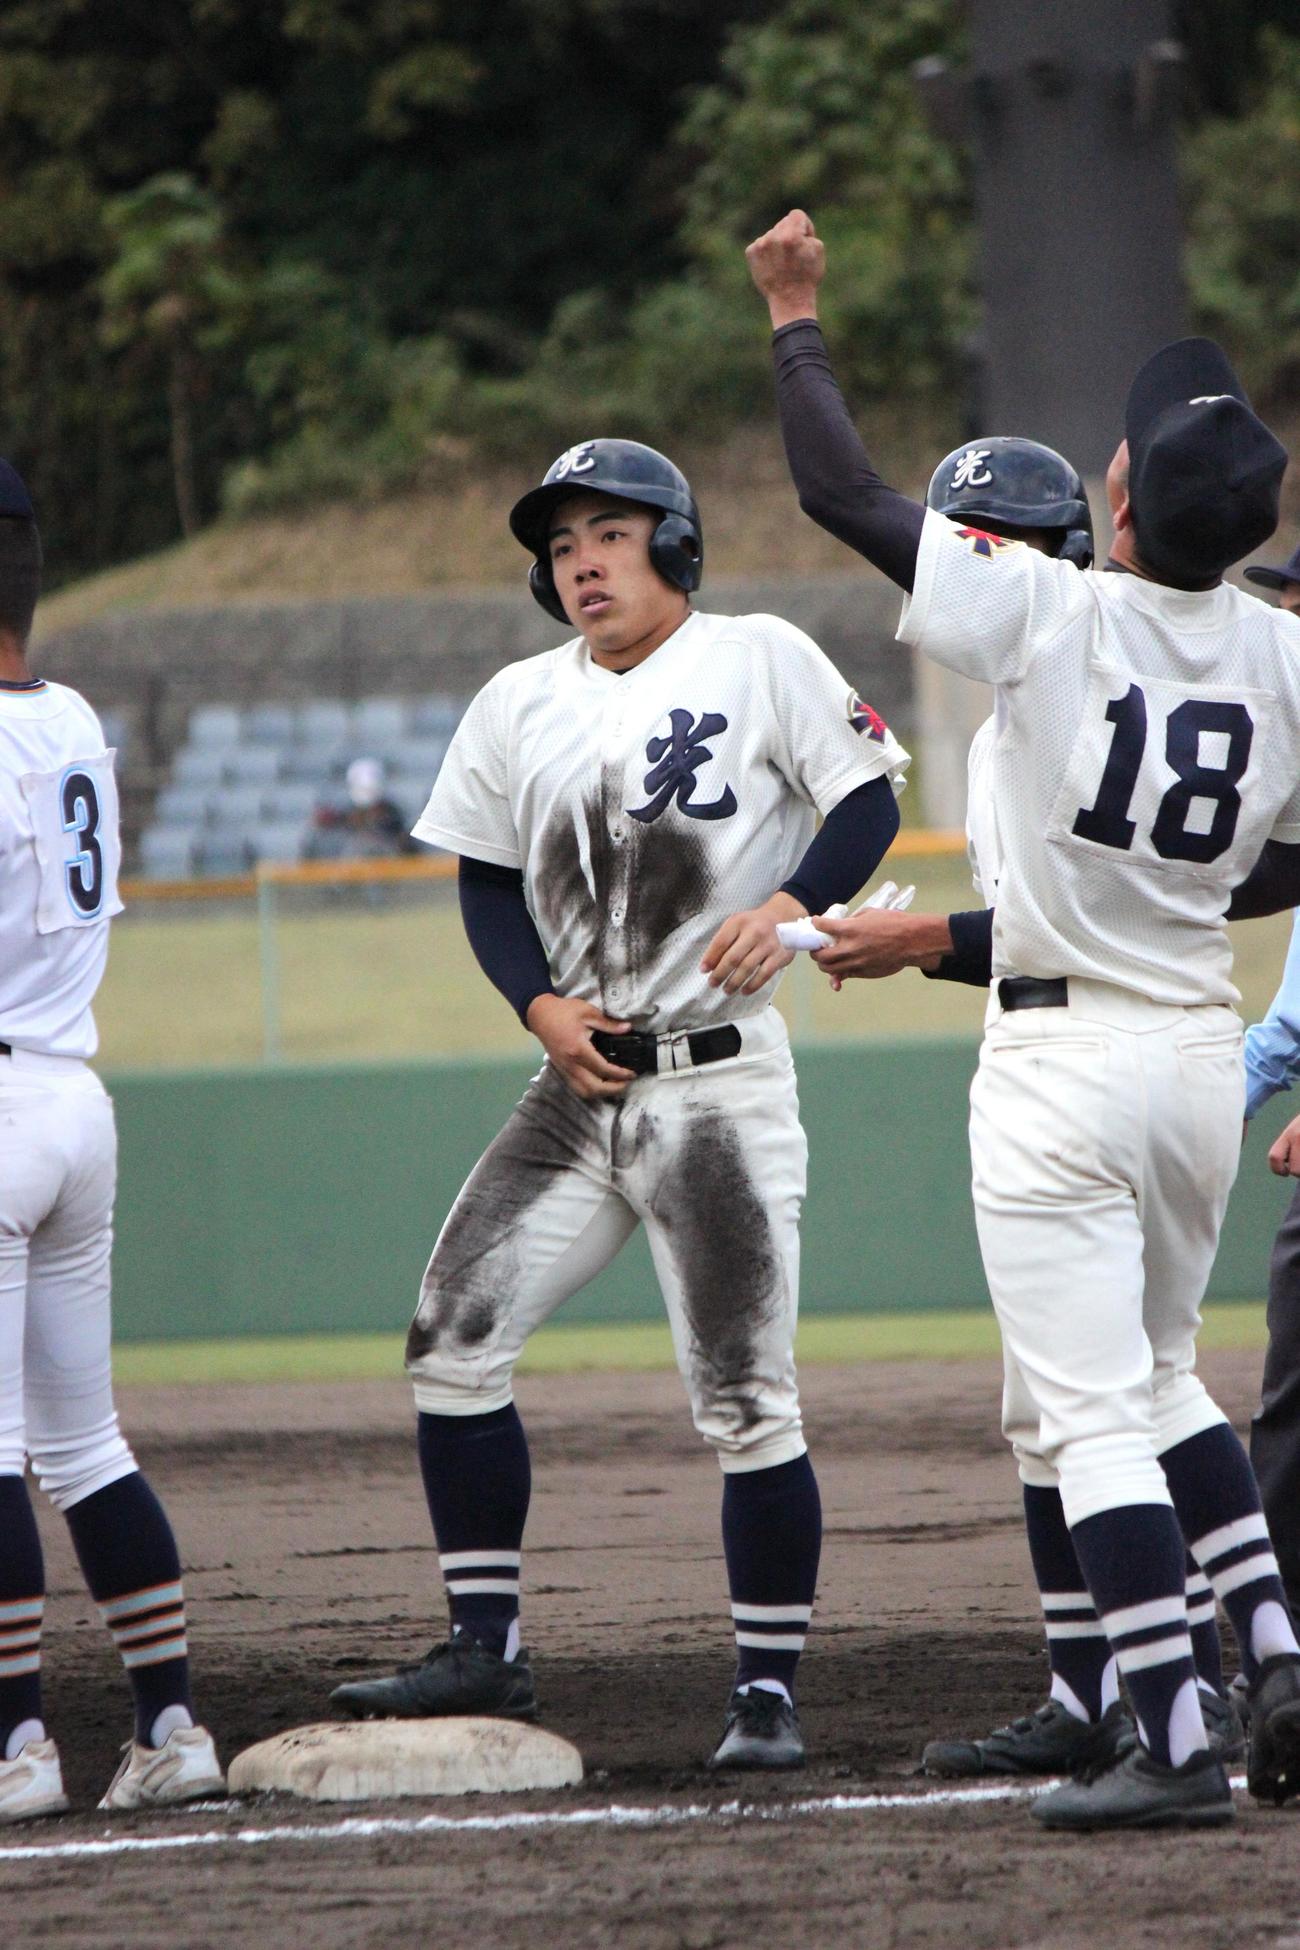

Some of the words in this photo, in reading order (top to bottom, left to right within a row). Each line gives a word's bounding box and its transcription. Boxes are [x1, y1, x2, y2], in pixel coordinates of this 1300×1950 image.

[950, 449, 993, 490] 光
[626, 708, 738, 824] 光
[1073, 682, 1254, 864] 18
[60, 767, 102, 919] 3
